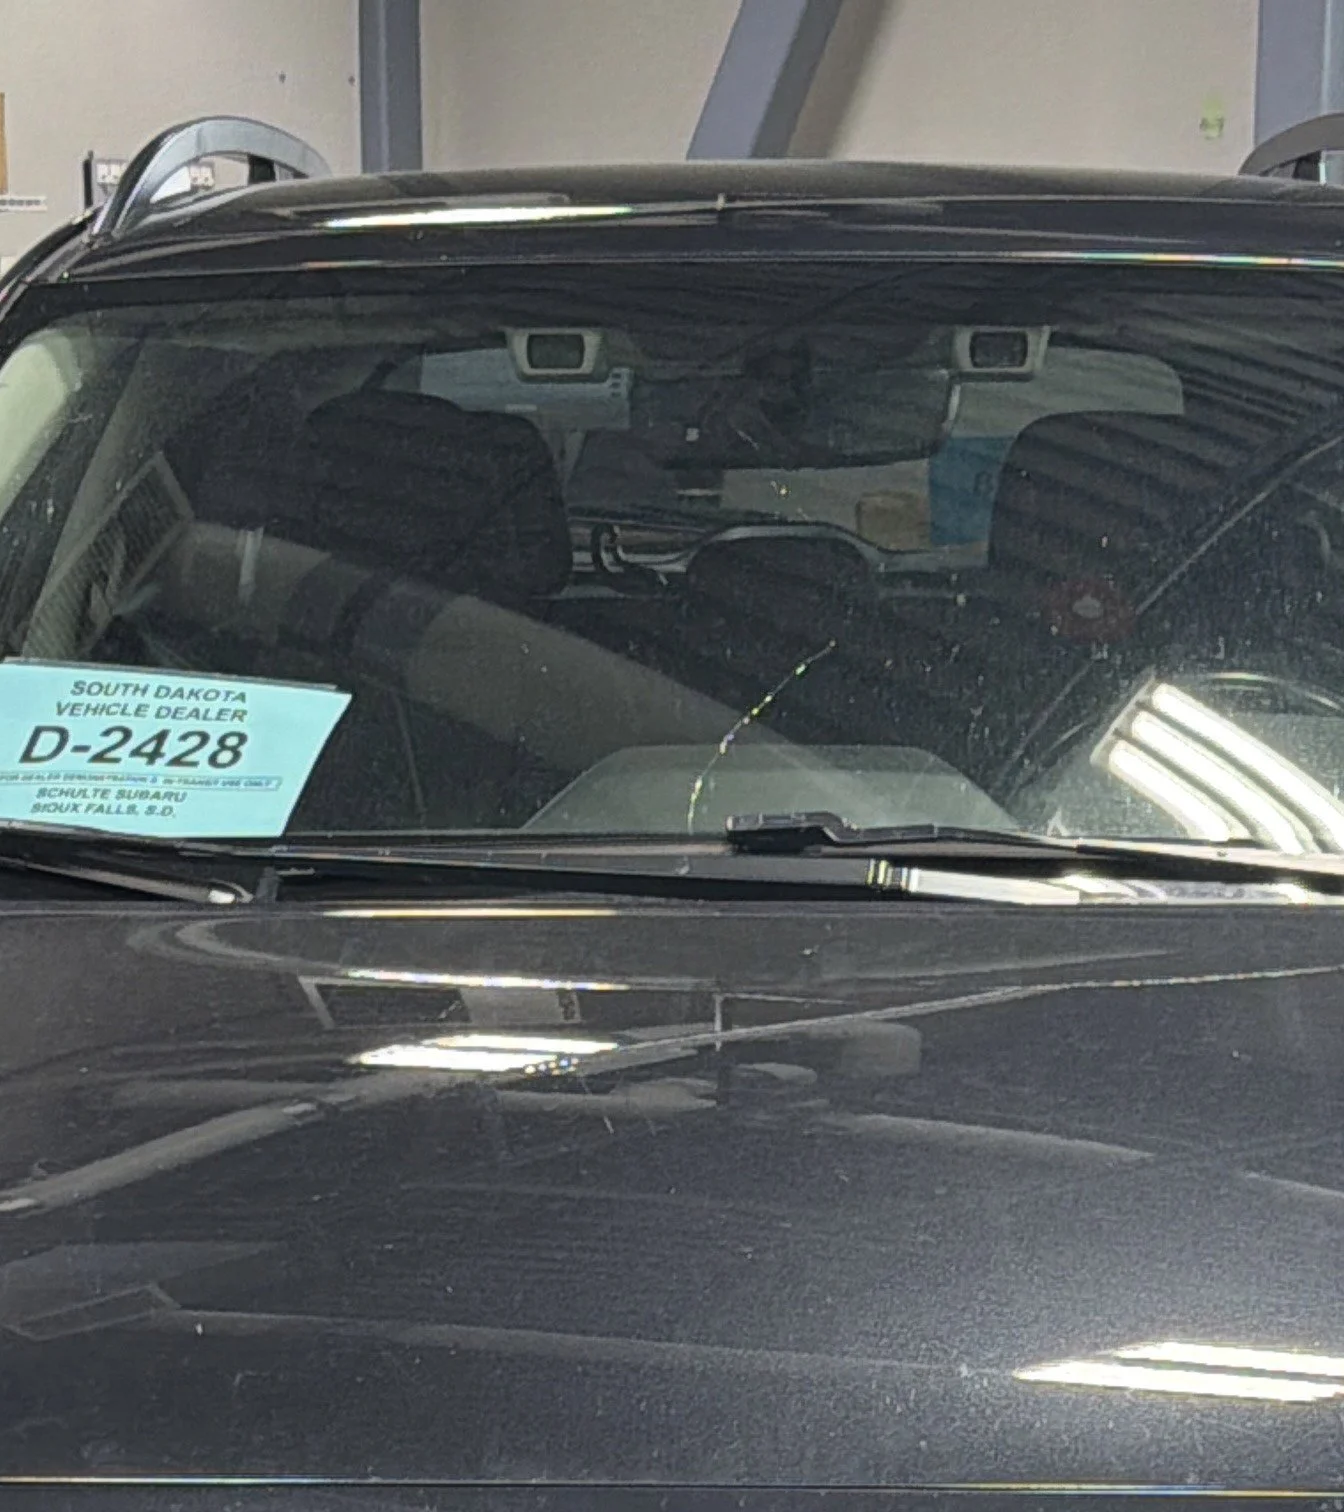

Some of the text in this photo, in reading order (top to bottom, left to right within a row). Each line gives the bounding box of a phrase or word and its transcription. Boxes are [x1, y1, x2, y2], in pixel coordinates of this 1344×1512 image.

[70, 680, 247, 704] SOUTH DAKOTA
[55, 700, 248, 723] VEHICLE DEALER
[18, 725, 249, 769] D-2428
[35, 787, 187, 802] SCHULTE SUBARU
[30, 802, 80, 814] SIOUX
[144, 805, 176, 817] S.D.
